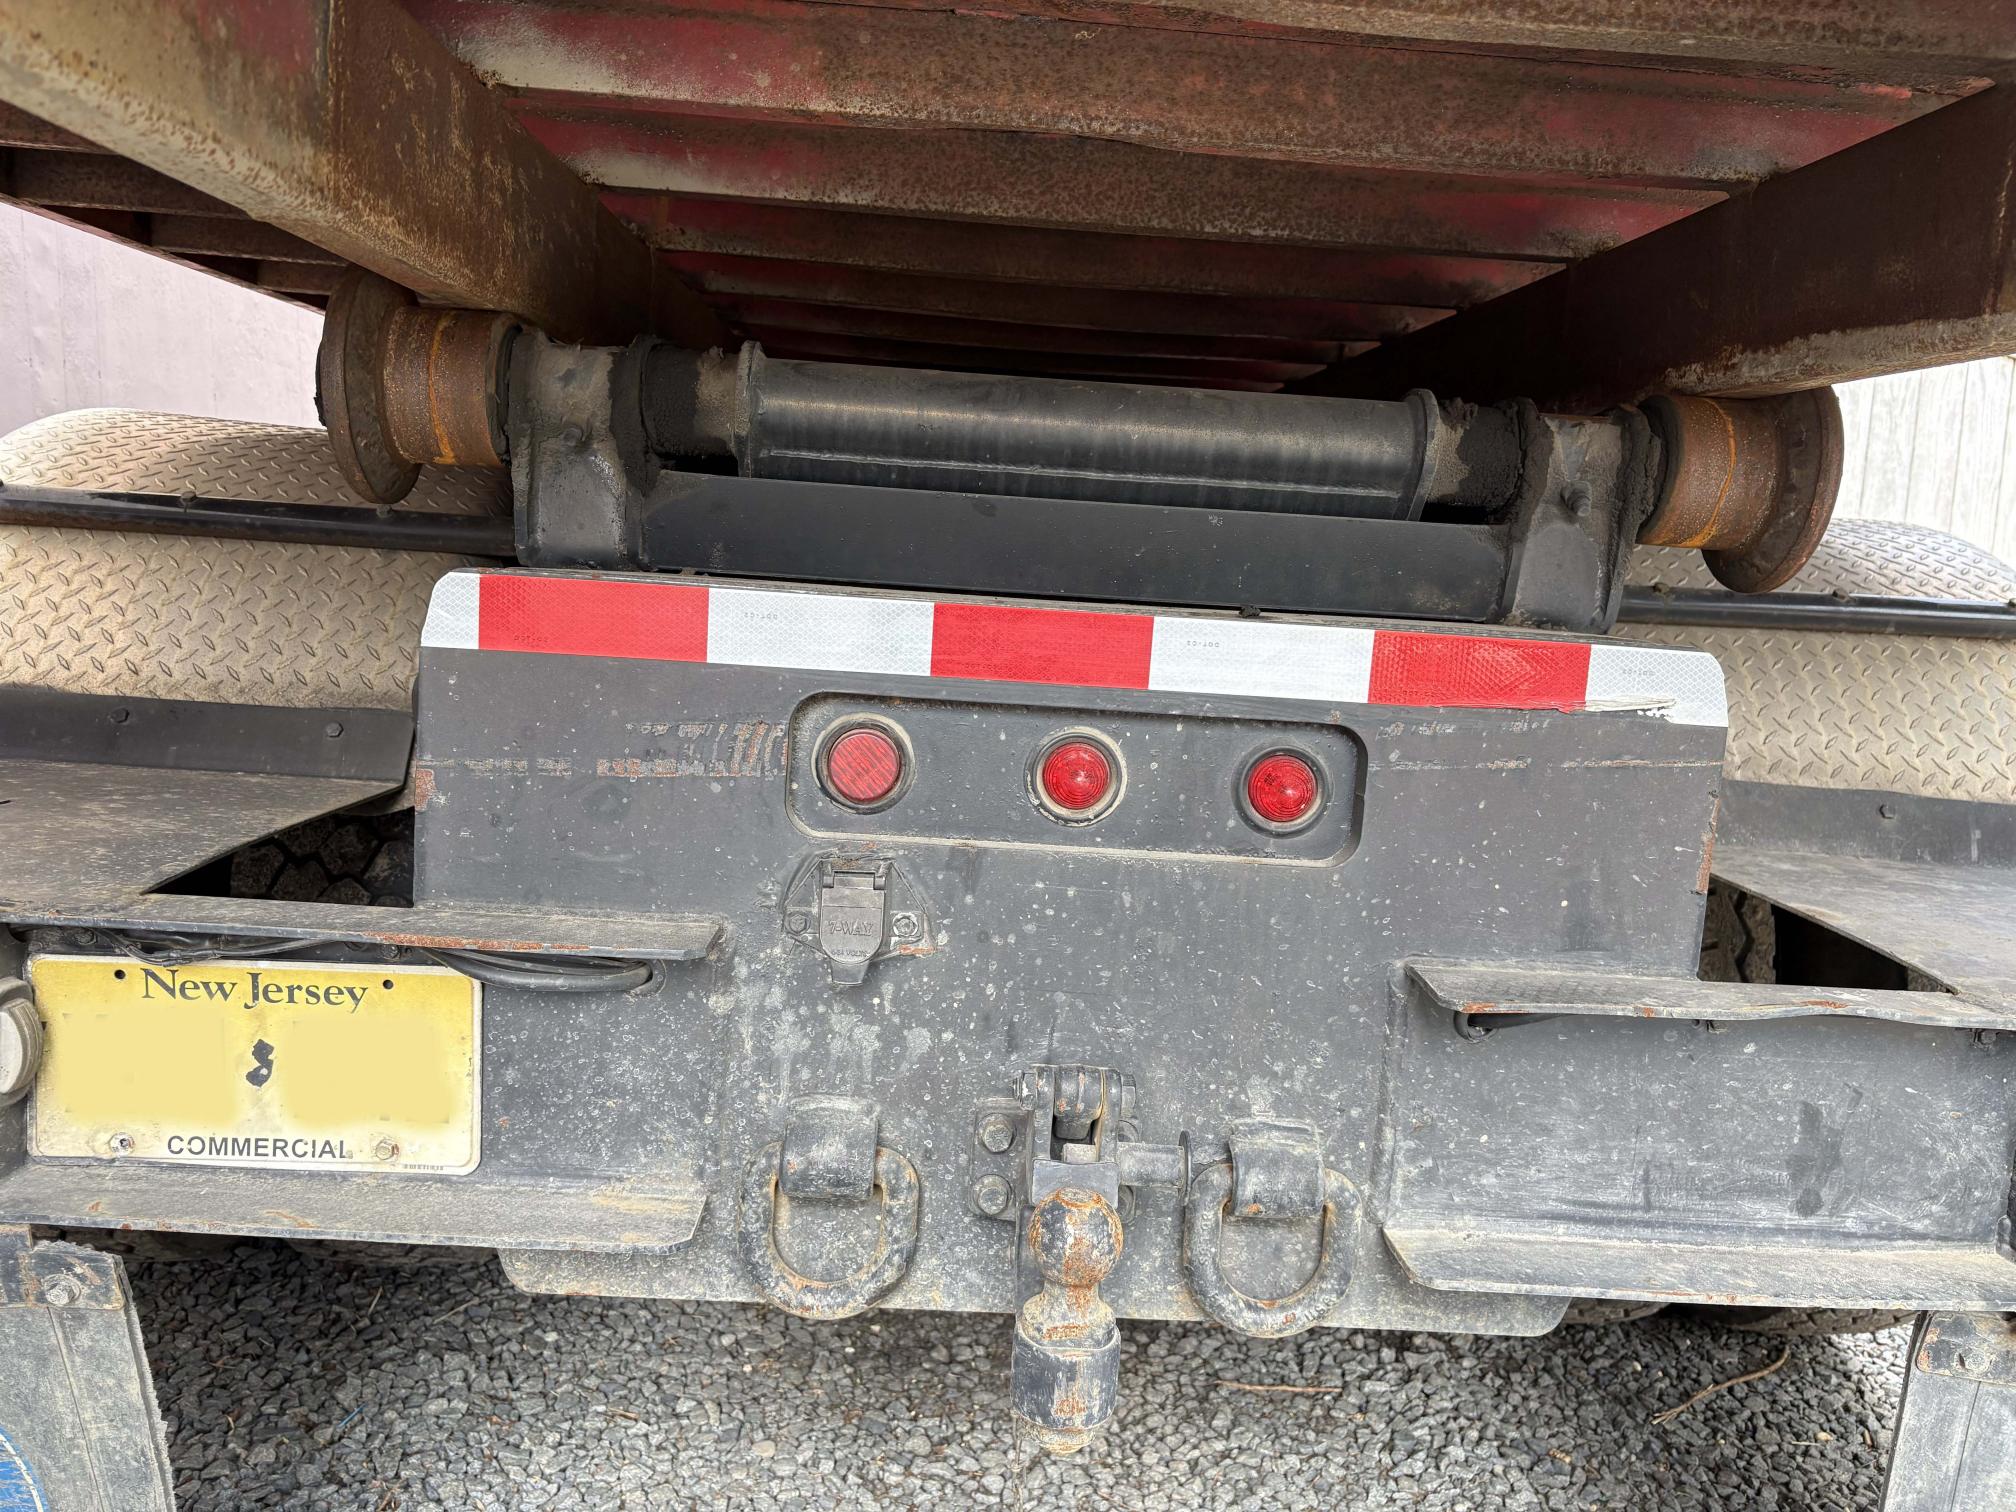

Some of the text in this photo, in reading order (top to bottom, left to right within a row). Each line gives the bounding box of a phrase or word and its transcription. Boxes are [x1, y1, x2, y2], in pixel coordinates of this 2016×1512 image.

[829, 920, 874, 937] 7-WAY
[140, 967, 368, 1014] New Jersey
[167, 1135, 350, 1159] COMMERCIAL
